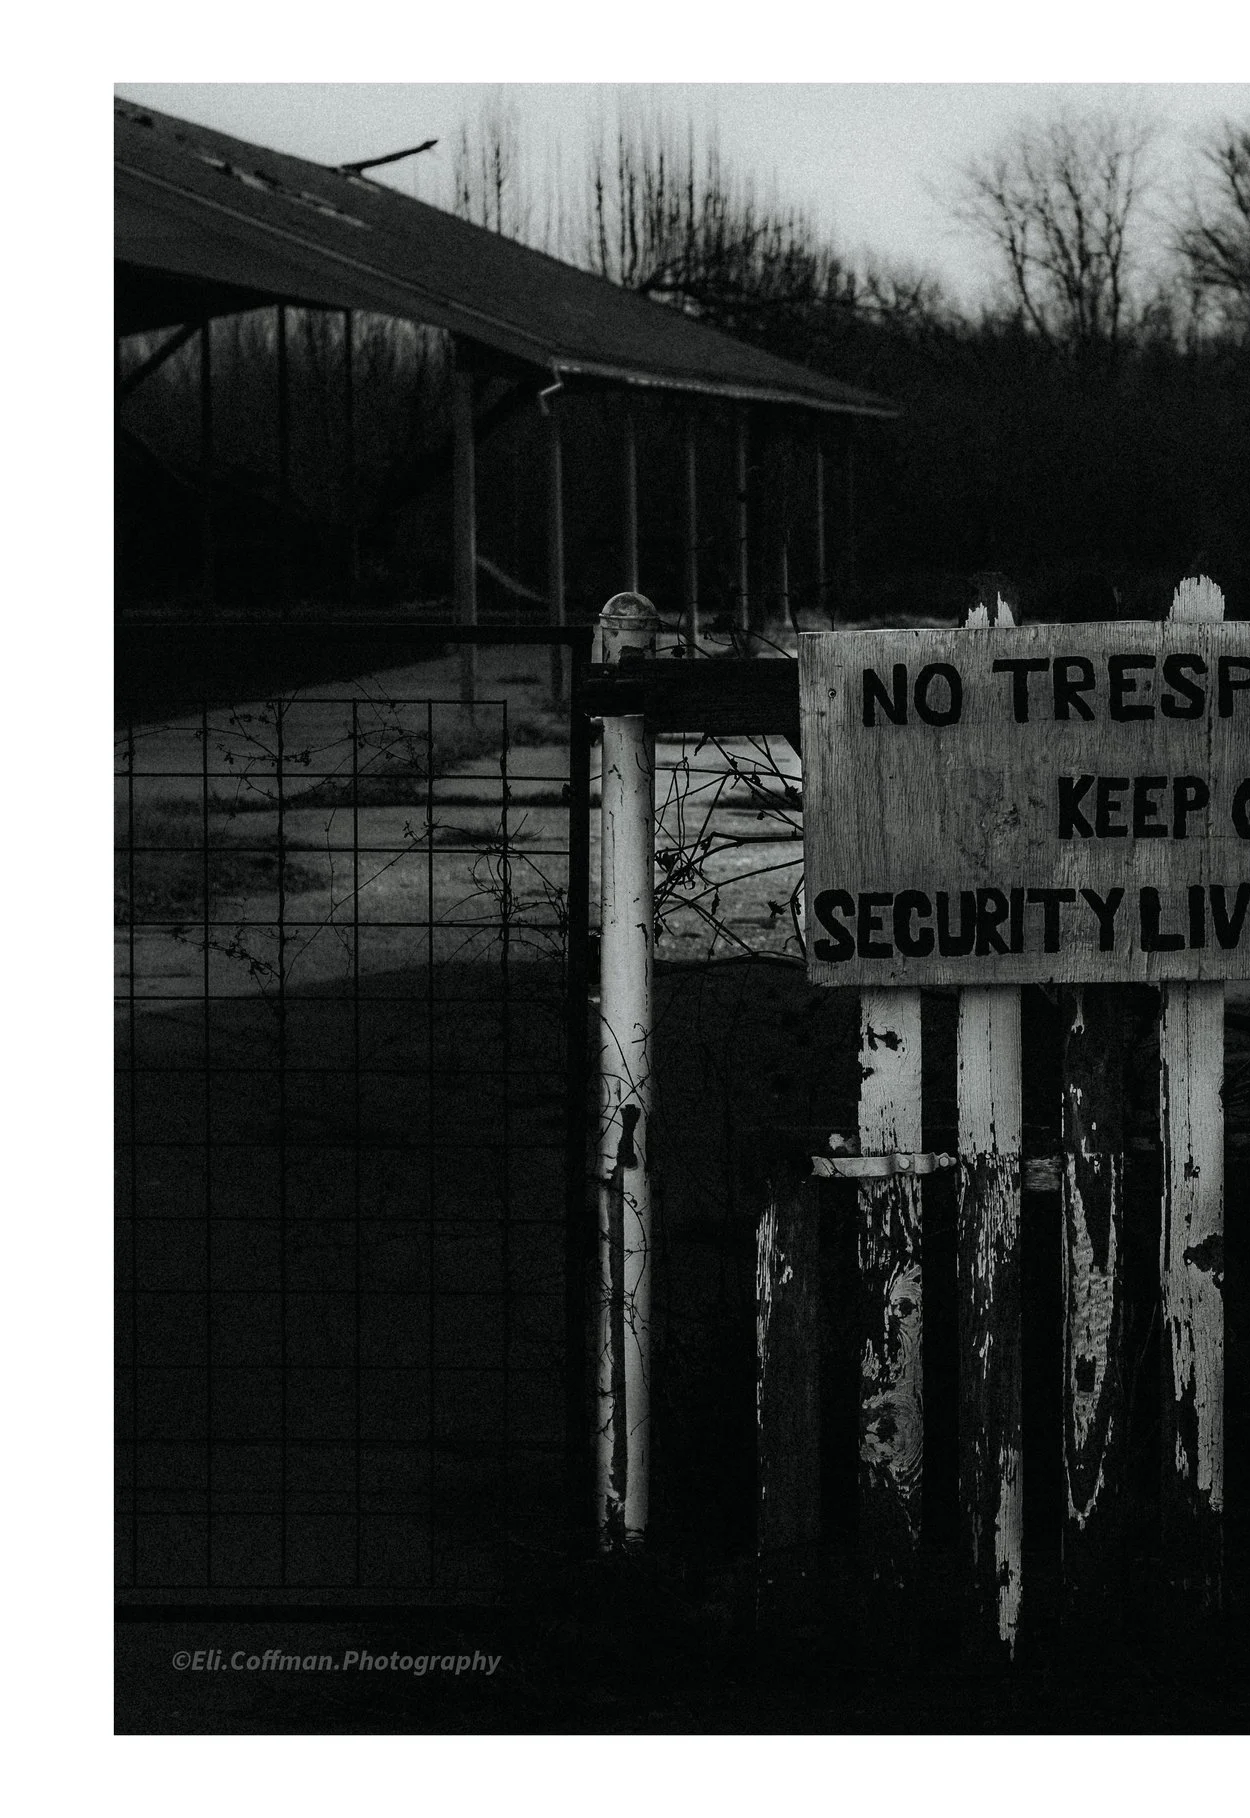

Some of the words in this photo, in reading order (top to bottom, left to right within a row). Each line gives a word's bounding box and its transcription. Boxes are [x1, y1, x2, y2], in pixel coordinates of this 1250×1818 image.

[862, 662, 963, 728] NO
[1057, 775, 1209, 841] KEEP
[813, 887, 1125, 963] SECURITY
